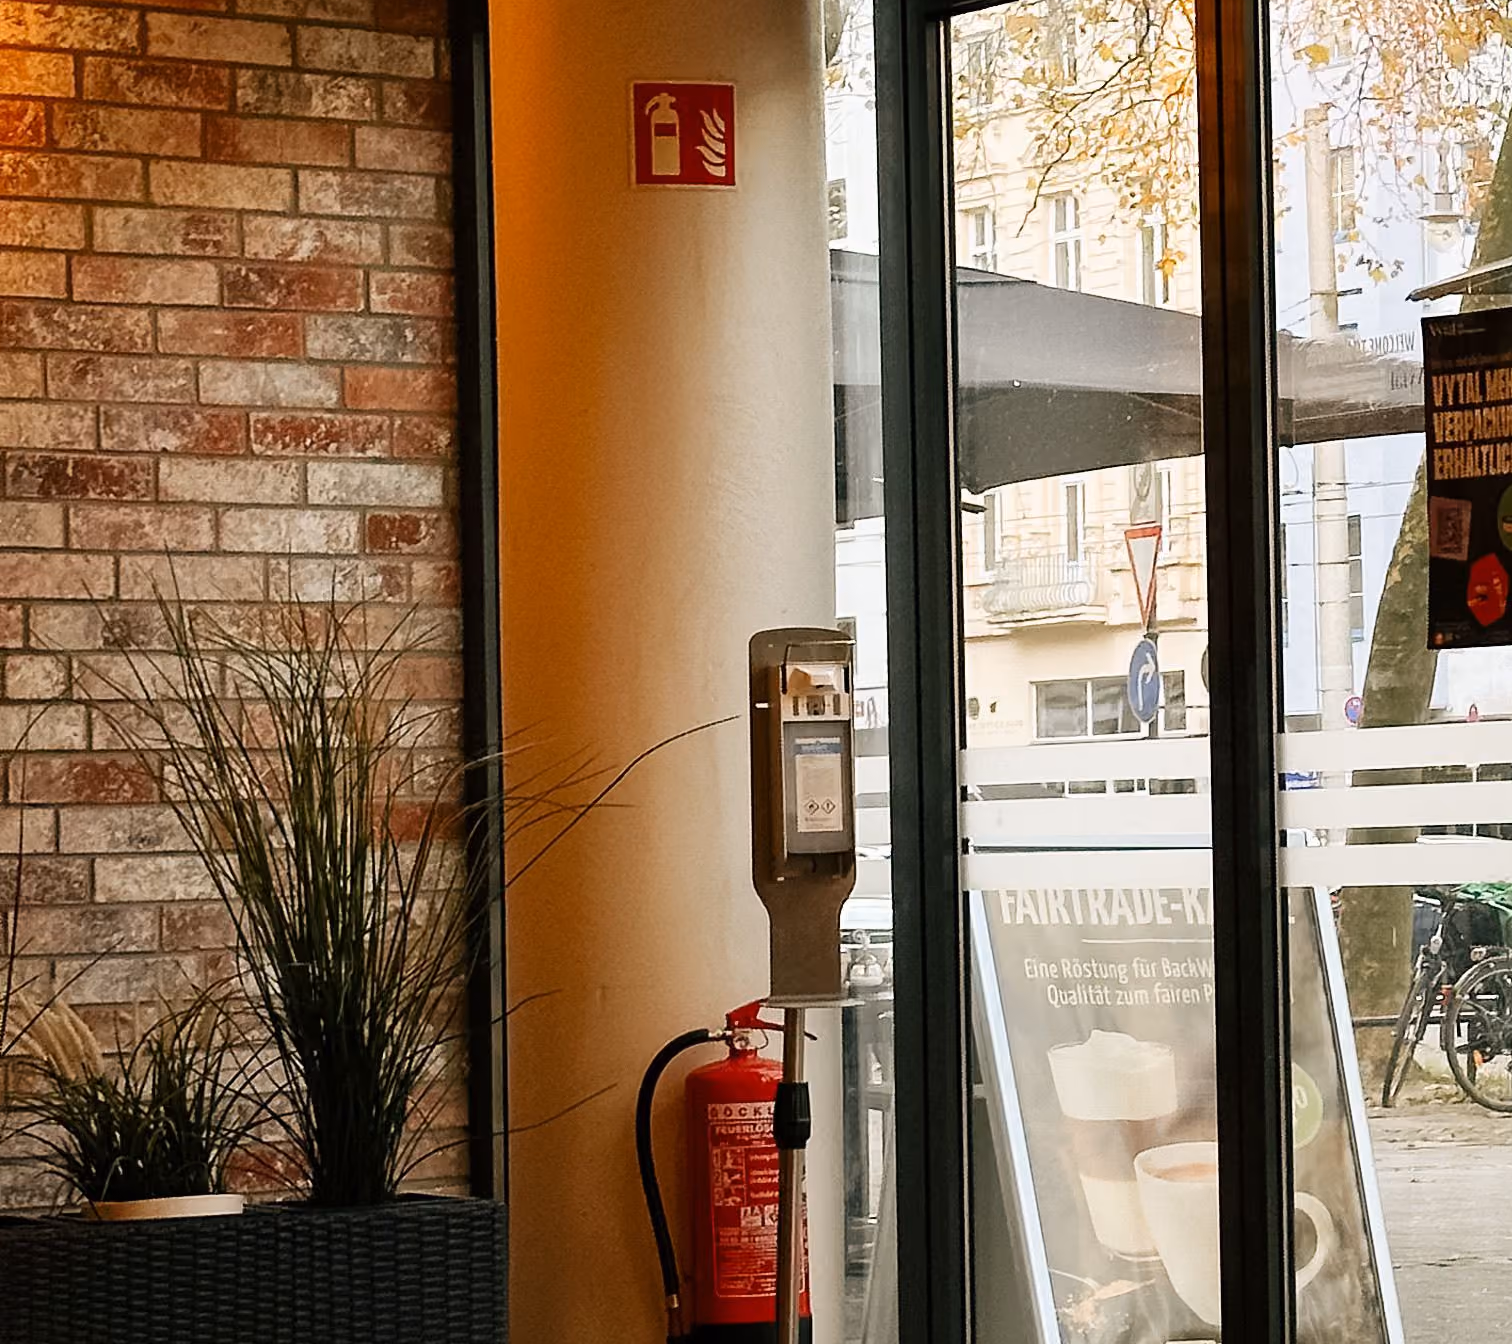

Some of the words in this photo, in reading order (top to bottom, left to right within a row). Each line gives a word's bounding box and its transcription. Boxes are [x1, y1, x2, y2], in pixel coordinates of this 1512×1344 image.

[1432, 371, 1483, 407] VYTAL
[999, 888, 1213, 925] FAIRTRADE-K
[1025, 958, 1058, 979] Eine
[1062, 958, 1129, 983] Röstung
[1133, 958, 1157, 978] für
[1162, 957, 1213, 978] BackW
[1047, 985, 1111, 1008] Qualität
[1116, 990, 1149, 1005] zum
[1154, 982, 1201, 1004] fairen
[1203, 983, 1213, 1003] P
